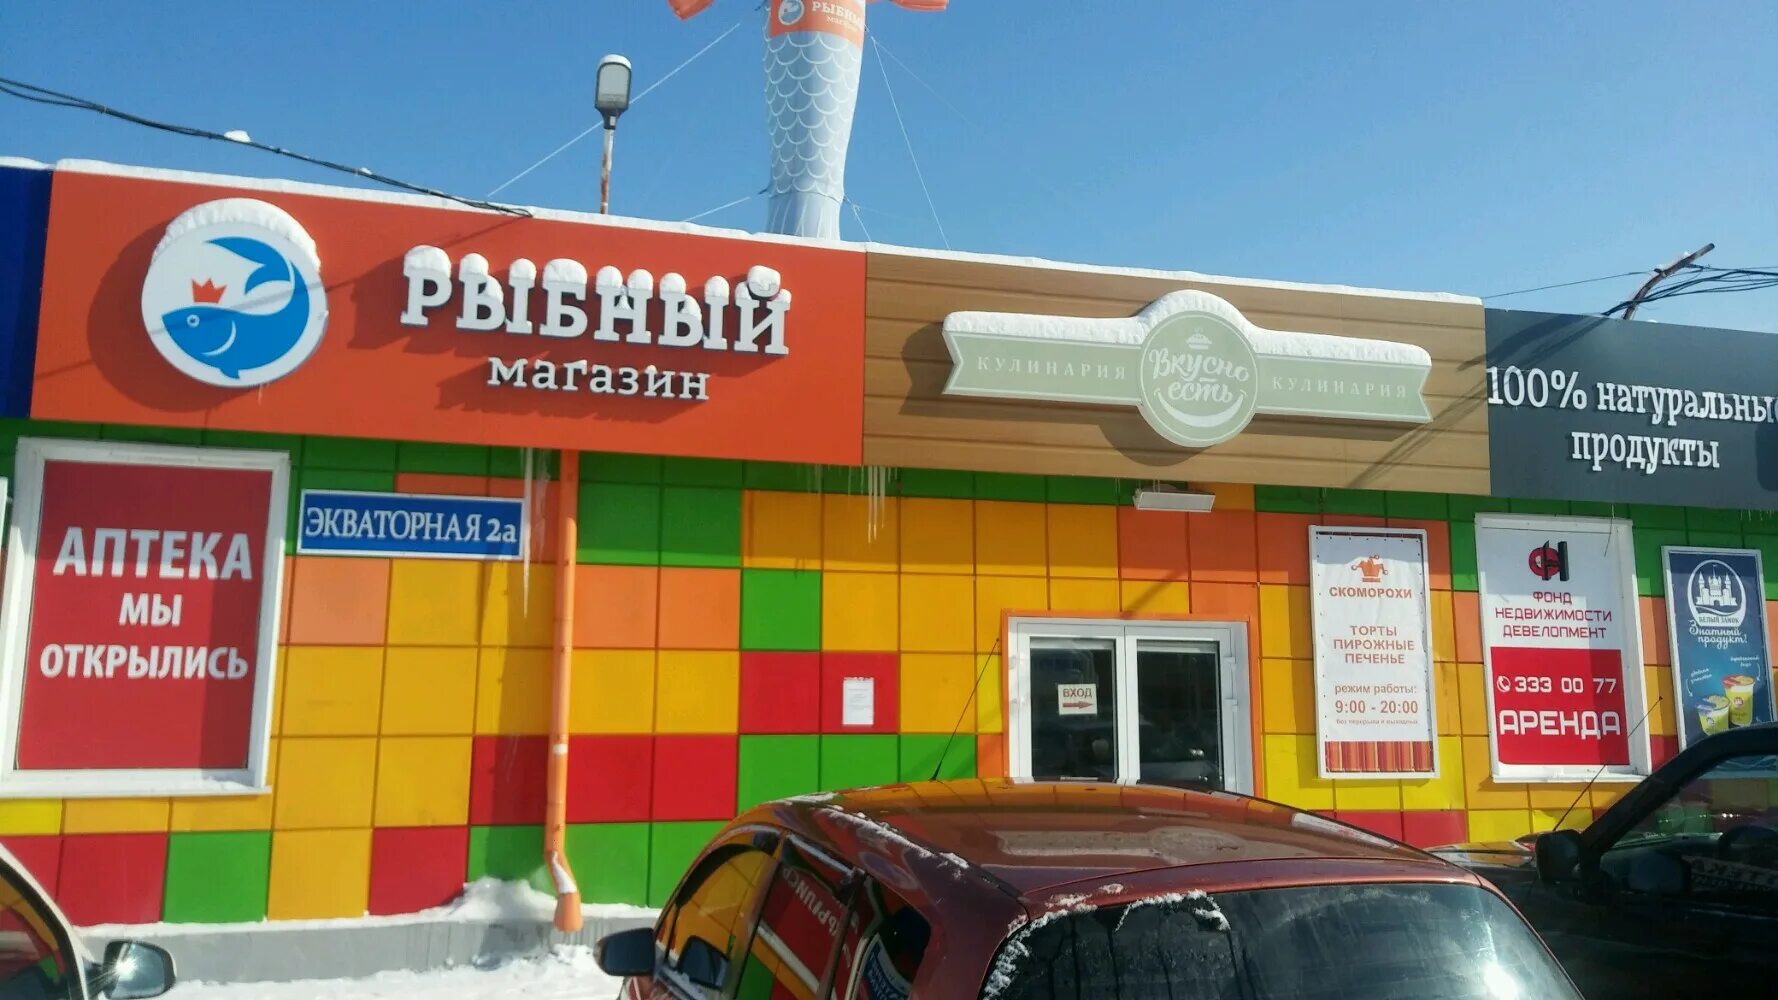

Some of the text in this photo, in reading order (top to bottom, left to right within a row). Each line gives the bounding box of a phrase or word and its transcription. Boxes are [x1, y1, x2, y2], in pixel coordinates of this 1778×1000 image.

[400, 265, 791, 356] РЫБНЫЙ
[977, 355, 1126, 380] КУЛИНАРИЯ
[487, 357, 710, 400] магазин
[1271, 375, 1407, 399] КУЛИНАРИЯ
[1487, 365, 1778, 426] 100% натуральны
[1571, 431, 1720, 475] продукты
[305, 507, 517, 543] ЭКВАТОРНАЯ 2а
[52, 527, 253, 580] АПТЕКА
[1329, 586, 1412, 598] СКОМОРОХИ
[1533, 591, 1572, 605] ФОНД
[118, 593, 182, 627] МЫ
[1495, 608, 1612, 622] НЕДВИЖИМОСТИ
[1350, 625, 1397, 636] ТОРТЫ
[1503, 625, 1607, 639] ДЕВЕЛОПМЕНТ
[1333, 639, 1414, 651] ПИРОЖНЫЕ
[39, 643, 249, 680] ОТКРЫЛИСЬ
[1345, 653, 1405, 664] ПЕЧЕНЬЕ
[1063, 688, 1092, 698] ВХОД
[1335, 684, 1417, 695] режим работы:
[1515, 676, 1617, 694] 333 00 77
[1335, 700, 1366, 714] 9:00
[1380, 700, 1418, 714] 20:00
[1499, 709, 1621, 740] АРЕНДА
